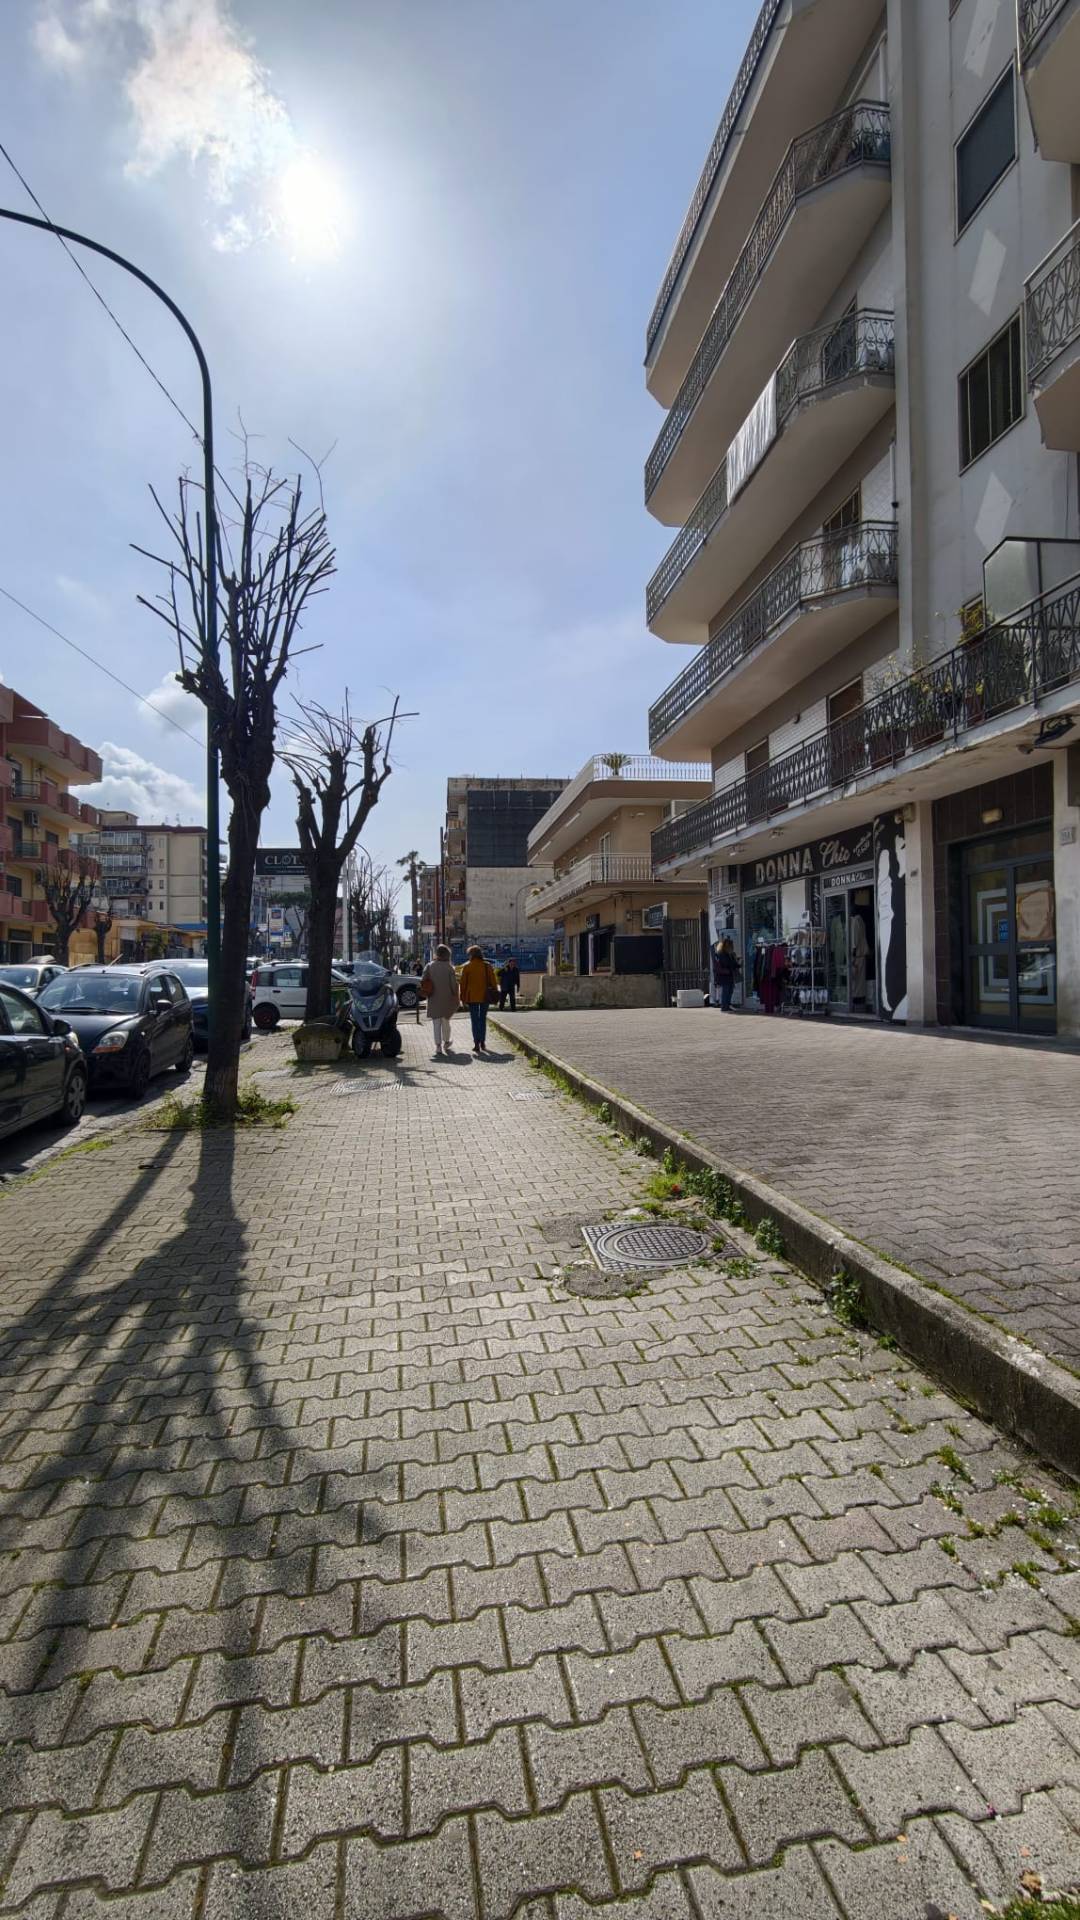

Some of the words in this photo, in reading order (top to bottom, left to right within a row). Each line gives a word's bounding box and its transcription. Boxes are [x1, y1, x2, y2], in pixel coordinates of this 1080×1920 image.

[755, 848, 814, 885] DONNA
[819, 840, 850, 868] Chic
[831, 873, 856, 887] DONNA
